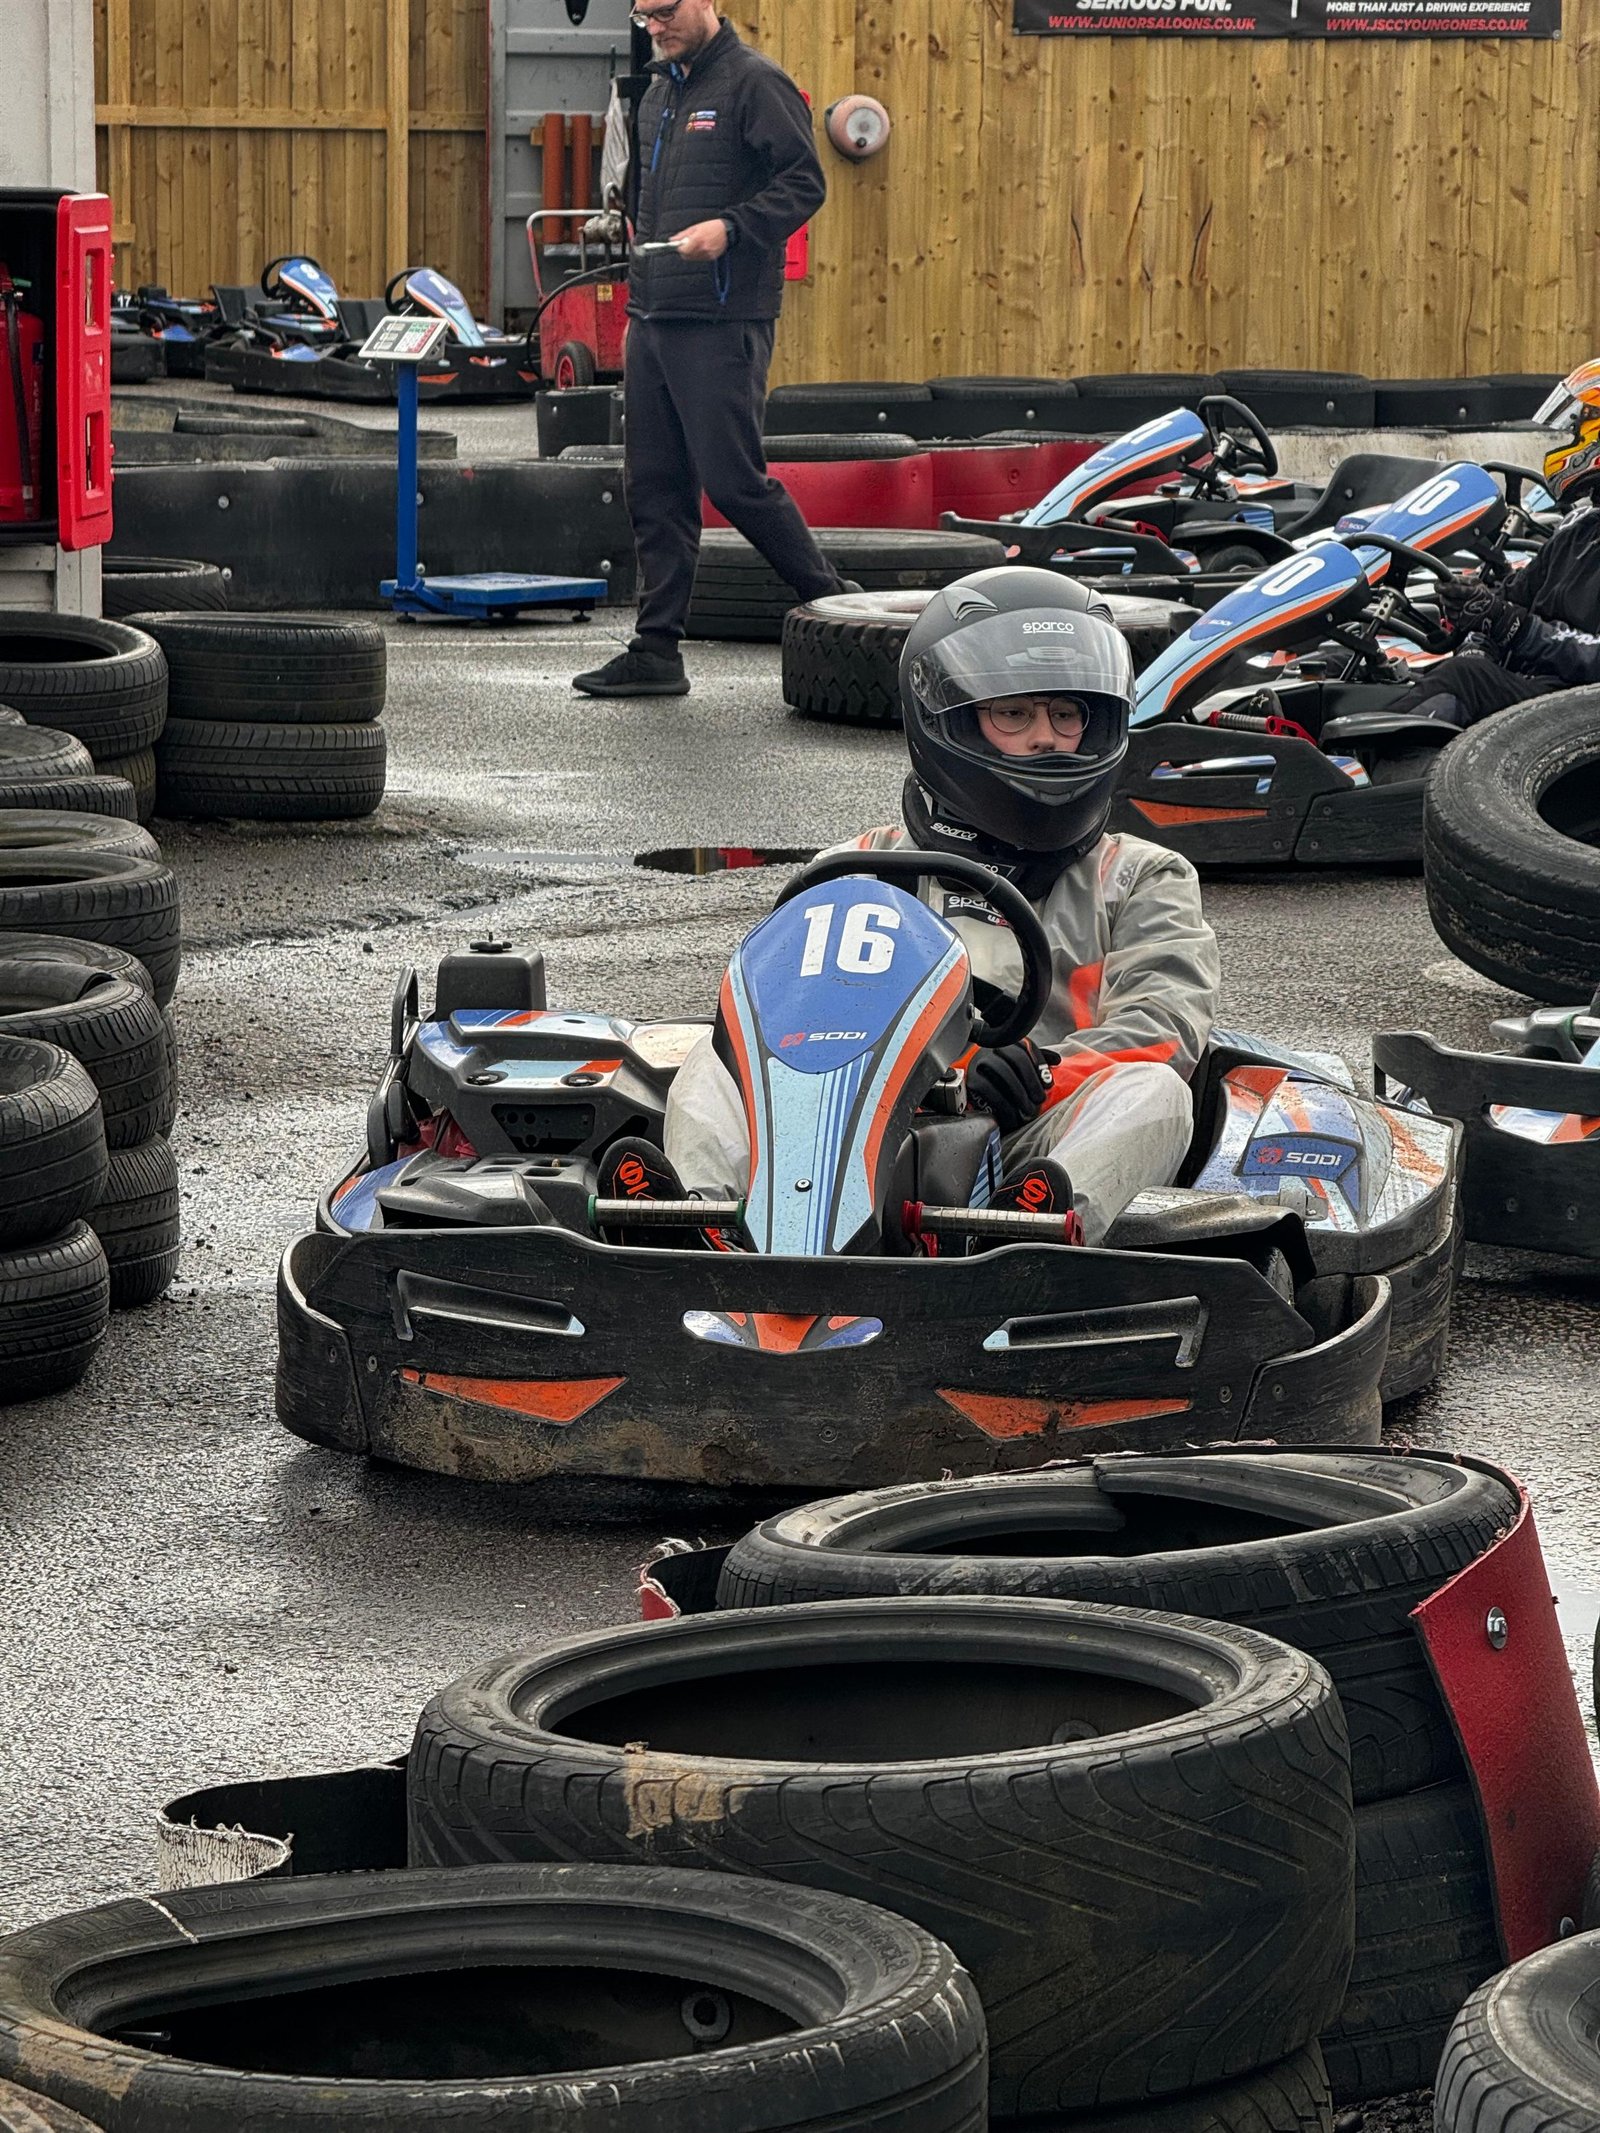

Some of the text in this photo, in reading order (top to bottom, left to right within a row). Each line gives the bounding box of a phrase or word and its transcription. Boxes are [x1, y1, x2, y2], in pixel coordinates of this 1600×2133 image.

[1326, 2, 1531, 12] MORE THAN JUST A DRIVING EXPERIENCE
[1048, 16, 1256, 30] WWW.JUNIORSALOONS.CO.UK
[1326, 18, 1529, 31] WWW.JSCCYOUNGONES.CO.UK
[117, 295, 132, 308] 17
[1022, 621, 1075, 634] sparco
[930, 822, 978, 842] sparco
[800, 903, 901, 977] 16
[807, 1031, 868, 1042] SODI
[1284, 1152, 1343, 1166] SODI
